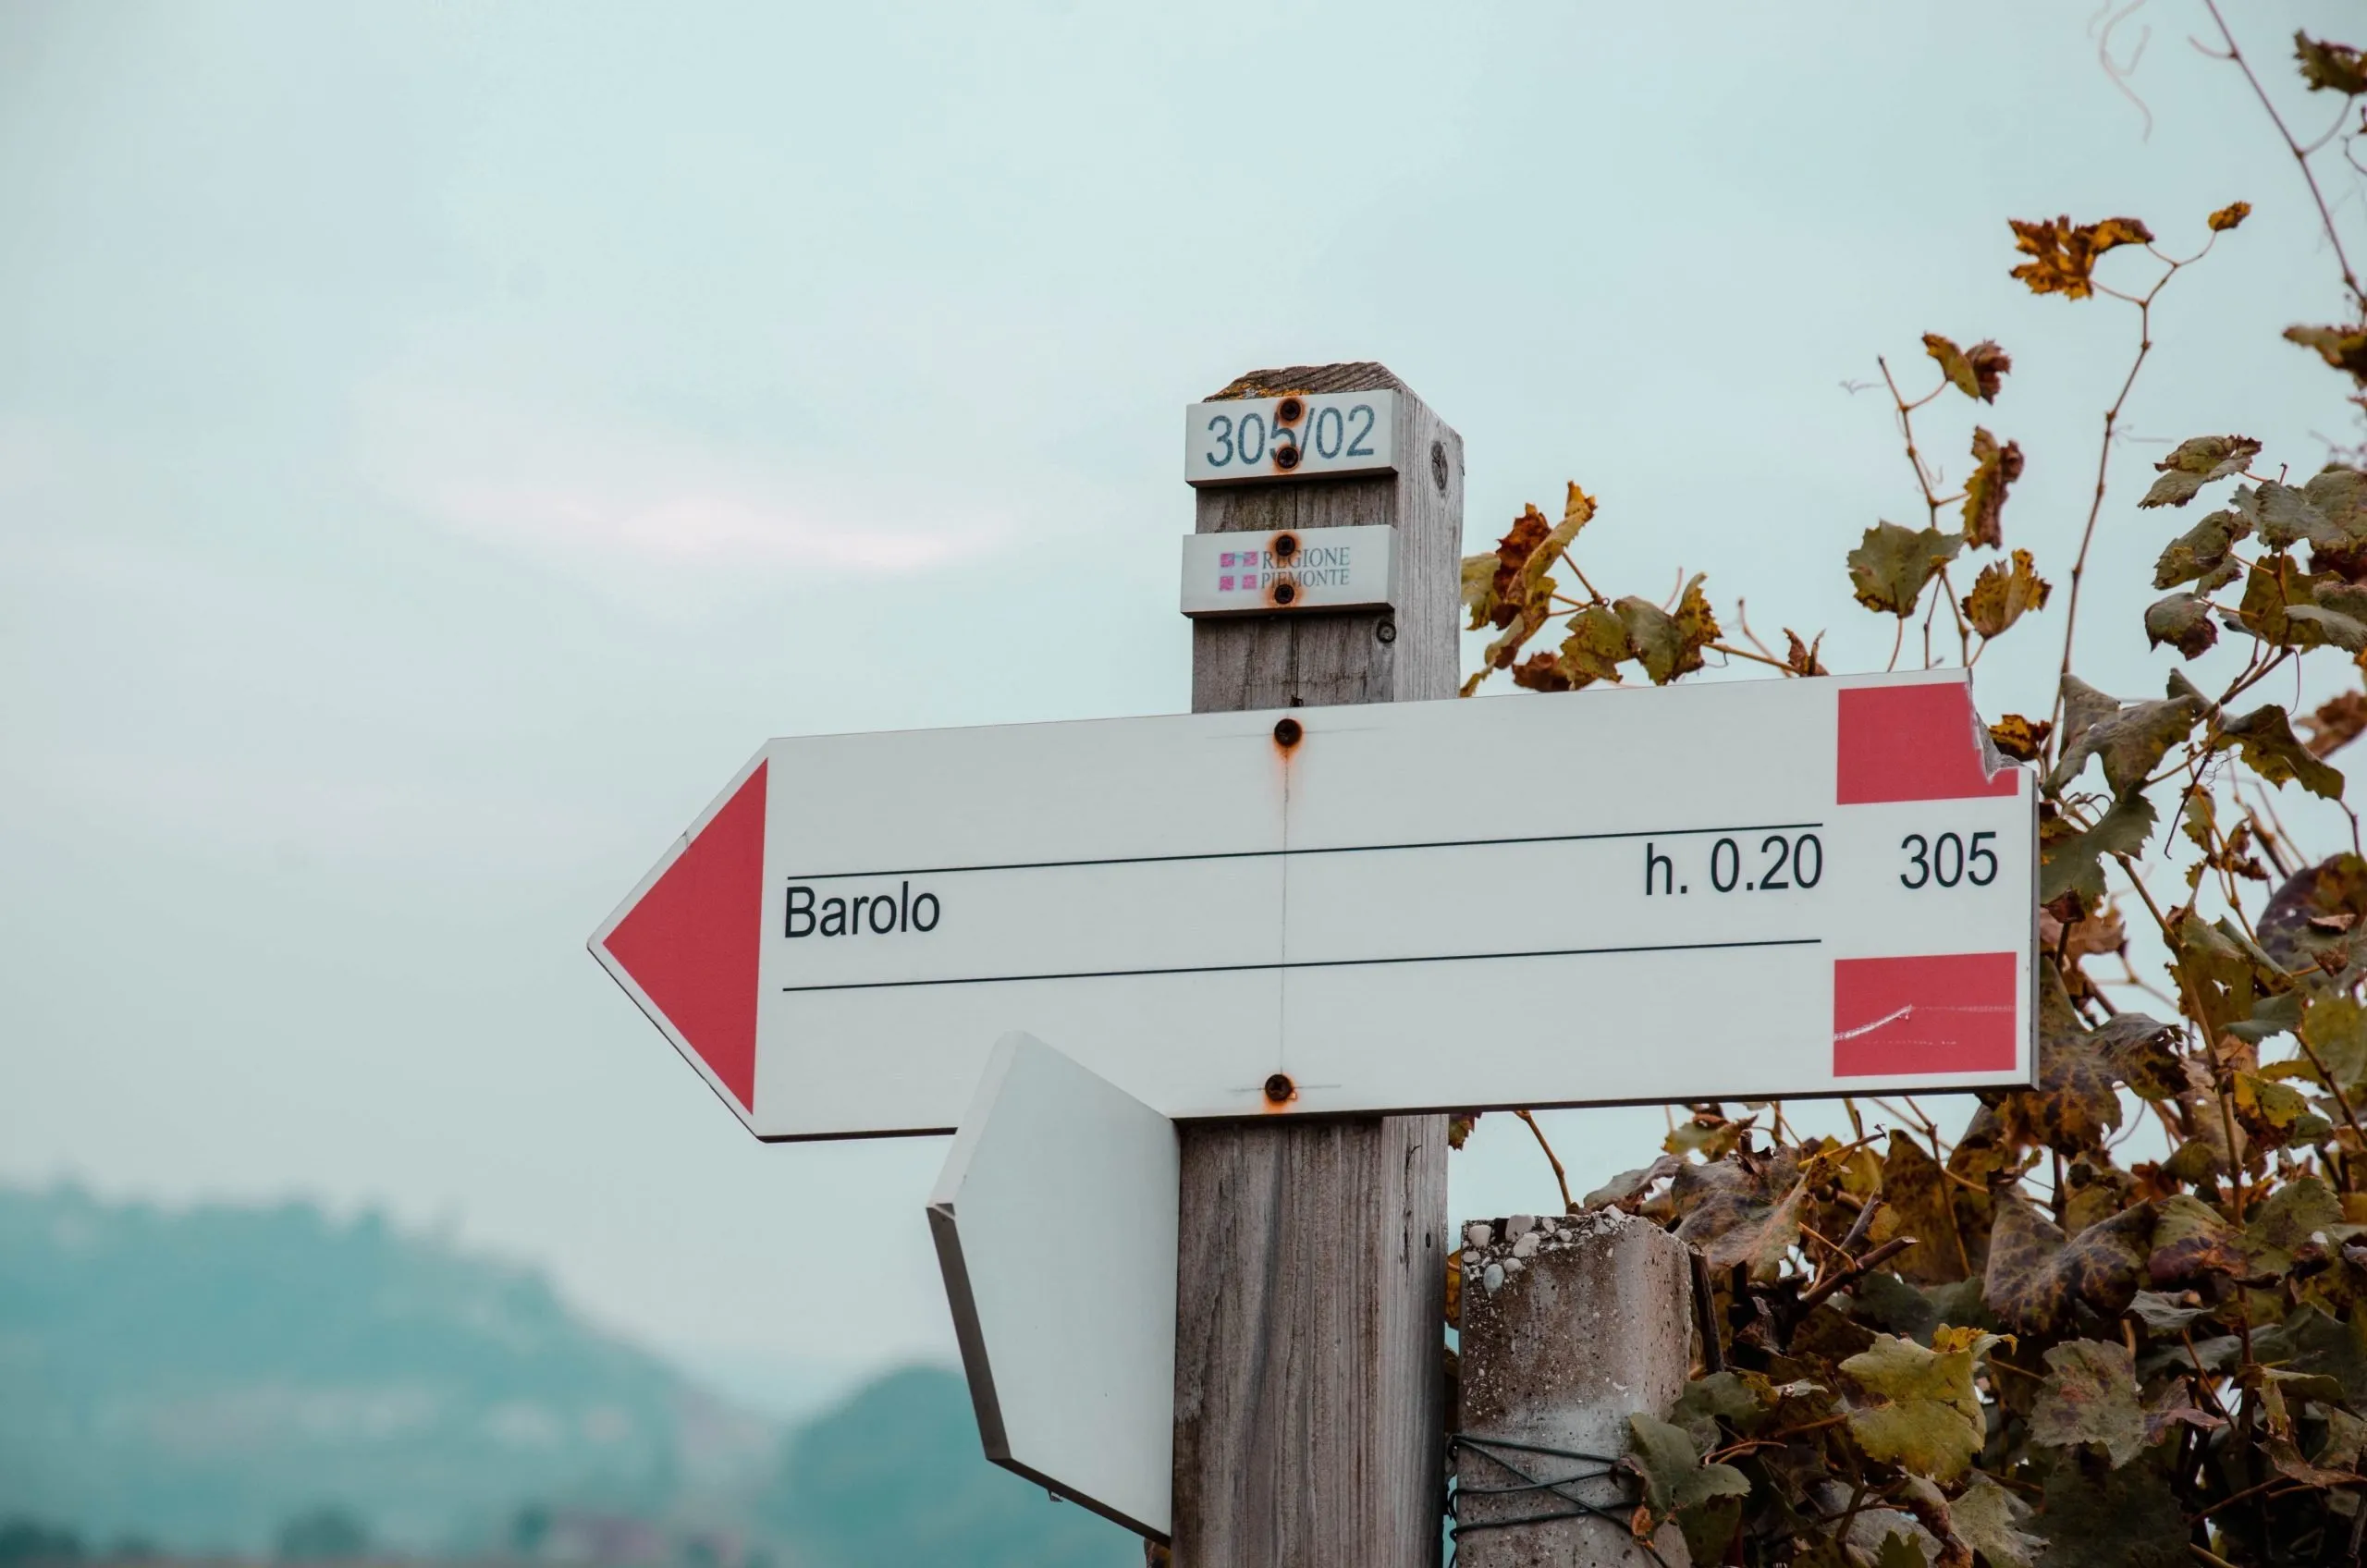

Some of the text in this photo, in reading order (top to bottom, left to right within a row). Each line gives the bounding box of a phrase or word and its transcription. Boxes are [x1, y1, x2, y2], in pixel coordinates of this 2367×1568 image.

[1206, 404, 1375, 467] 305/02
[1261, 569, 1351, 590] PIEMONTE
[1262, 546, 1351, 570] REGIONE
[1645, 833, 1823, 896] h. 0.20
[1899, 831, 1999, 889] 305
[784, 880, 940, 938] Barolo
